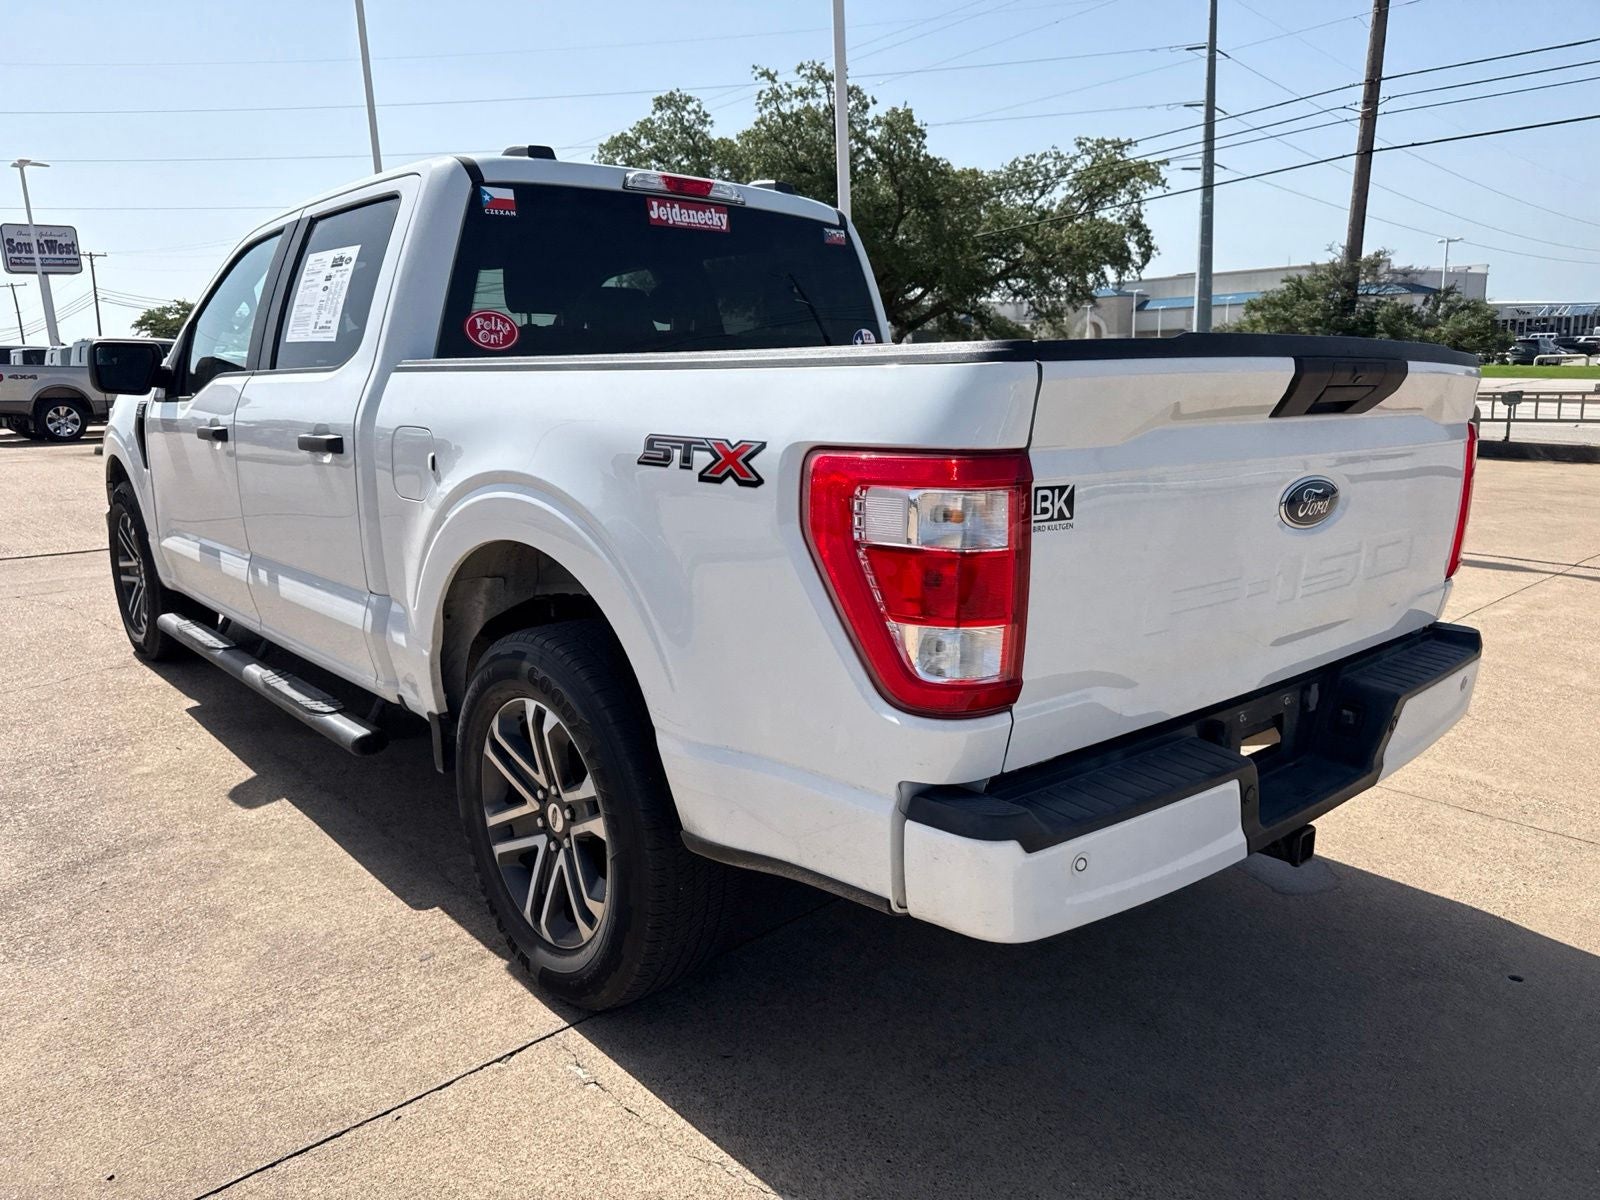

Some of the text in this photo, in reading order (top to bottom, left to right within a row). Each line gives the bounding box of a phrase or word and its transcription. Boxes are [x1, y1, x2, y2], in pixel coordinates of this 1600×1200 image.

[484, 208, 517, 216] CZEXAN
[649, 201, 728, 230] Jejdanečky
[6, 237, 78, 255] SouhWest
[475, 316, 511, 335] Polka
[478, 330, 504, 345] On!
[637, 433, 768, 488] STX
[1033, 484, 1074, 520] BK
[1297, 488, 1330, 518] Ford
